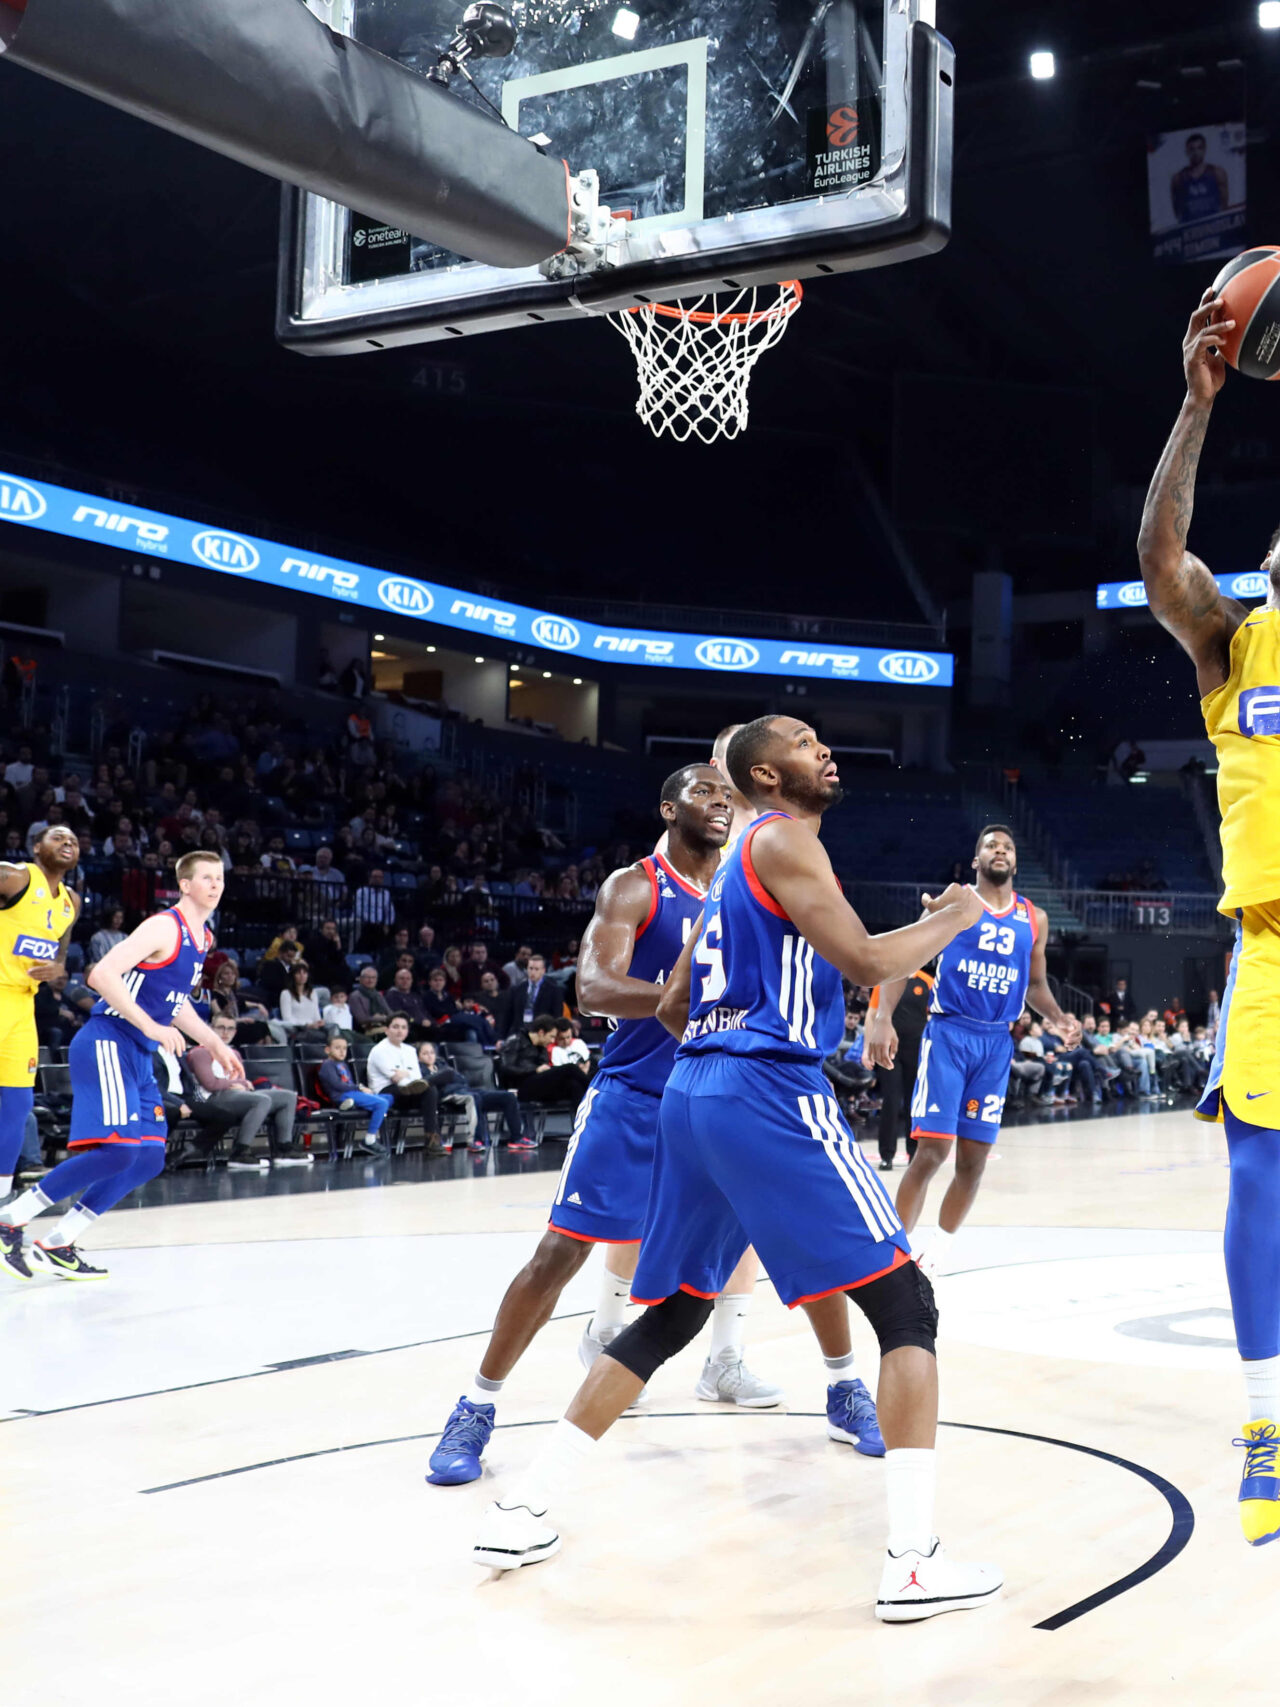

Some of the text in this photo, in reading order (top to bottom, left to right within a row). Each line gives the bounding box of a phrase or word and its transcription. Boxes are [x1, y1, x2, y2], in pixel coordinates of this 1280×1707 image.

[814, 156, 870, 177] AIRLINES
[815, 144, 870, 165] TURKISH
[814, 170, 870, 188] EuroLeague
[203, 536, 249, 567] KIA
[387, 582, 425, 609] KIA
[539, 620, 571, 645] KIA
[706, 644, 749, 665] KIA
[889, 656, 929, 677] KIA
[1137, 906, 1170, 926] 113
[978, 922, 1015, 956] 23
[967, 974, 1010, 995] EFES
[980, 1094, 1006, 1124] 2
